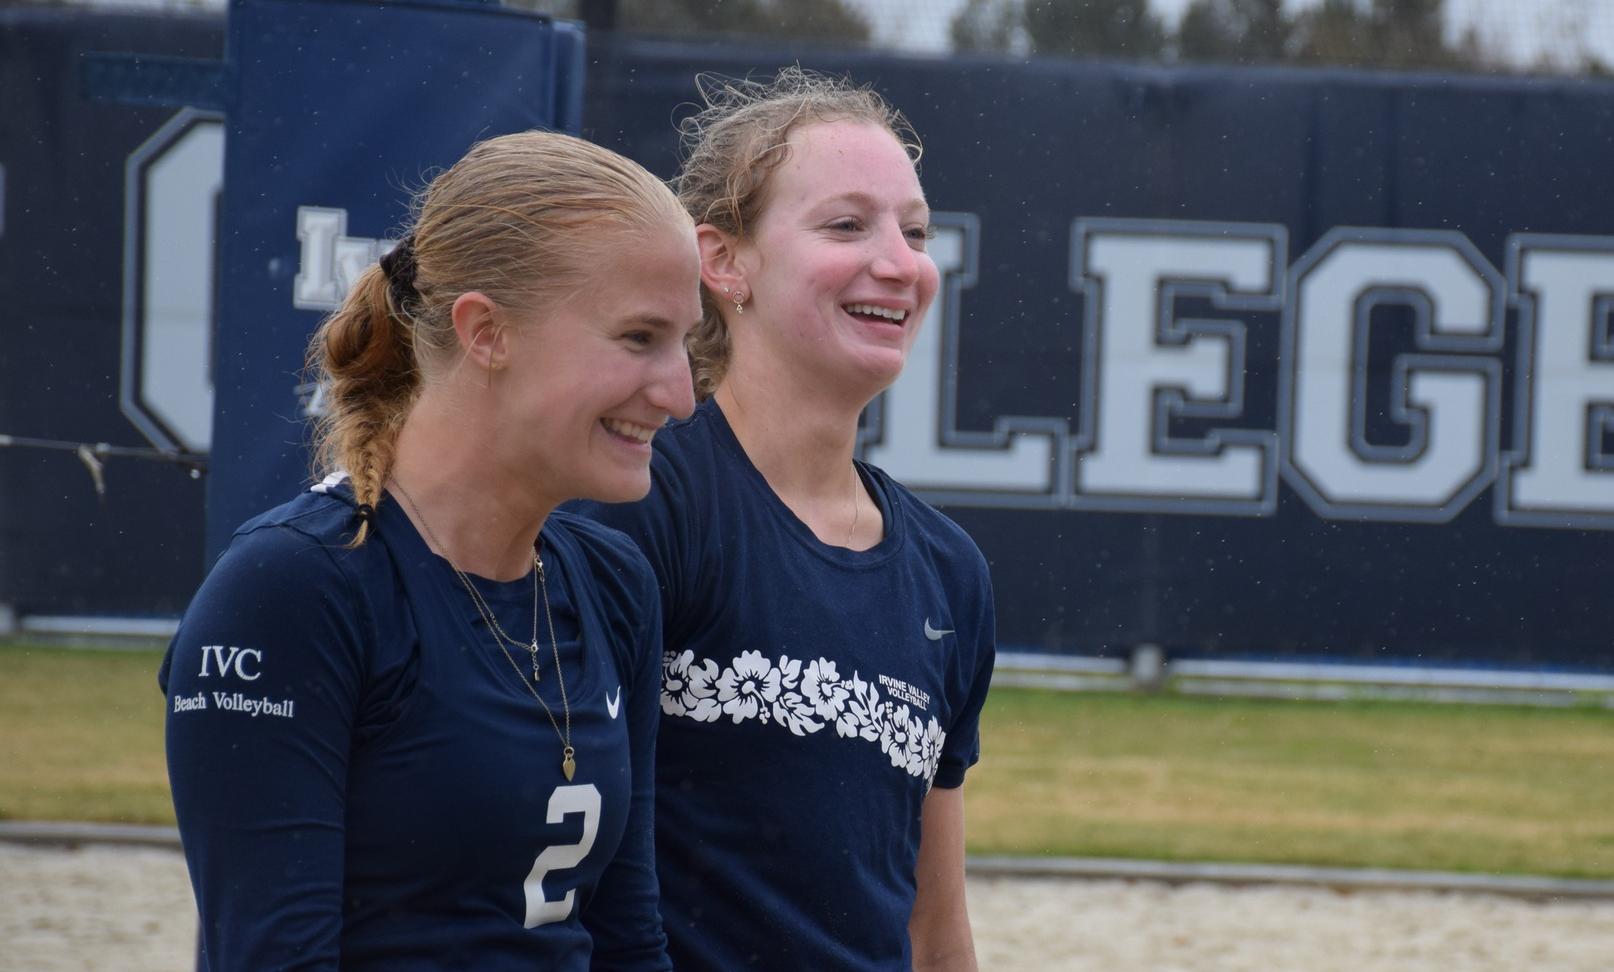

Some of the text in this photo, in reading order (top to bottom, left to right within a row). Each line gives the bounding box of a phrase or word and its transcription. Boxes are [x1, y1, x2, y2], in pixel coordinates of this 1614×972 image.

[866, 213, 1614, 529] LEGE
[198, 645, 262, 681] IVC
[173, 691, 294, 718] Beach Volleyball
[879, 674, 930, 704] IRVINE VALLEY
[887, 686, 927, 711] VOLLEYBALL
[524, 783, 602, 930] 2
